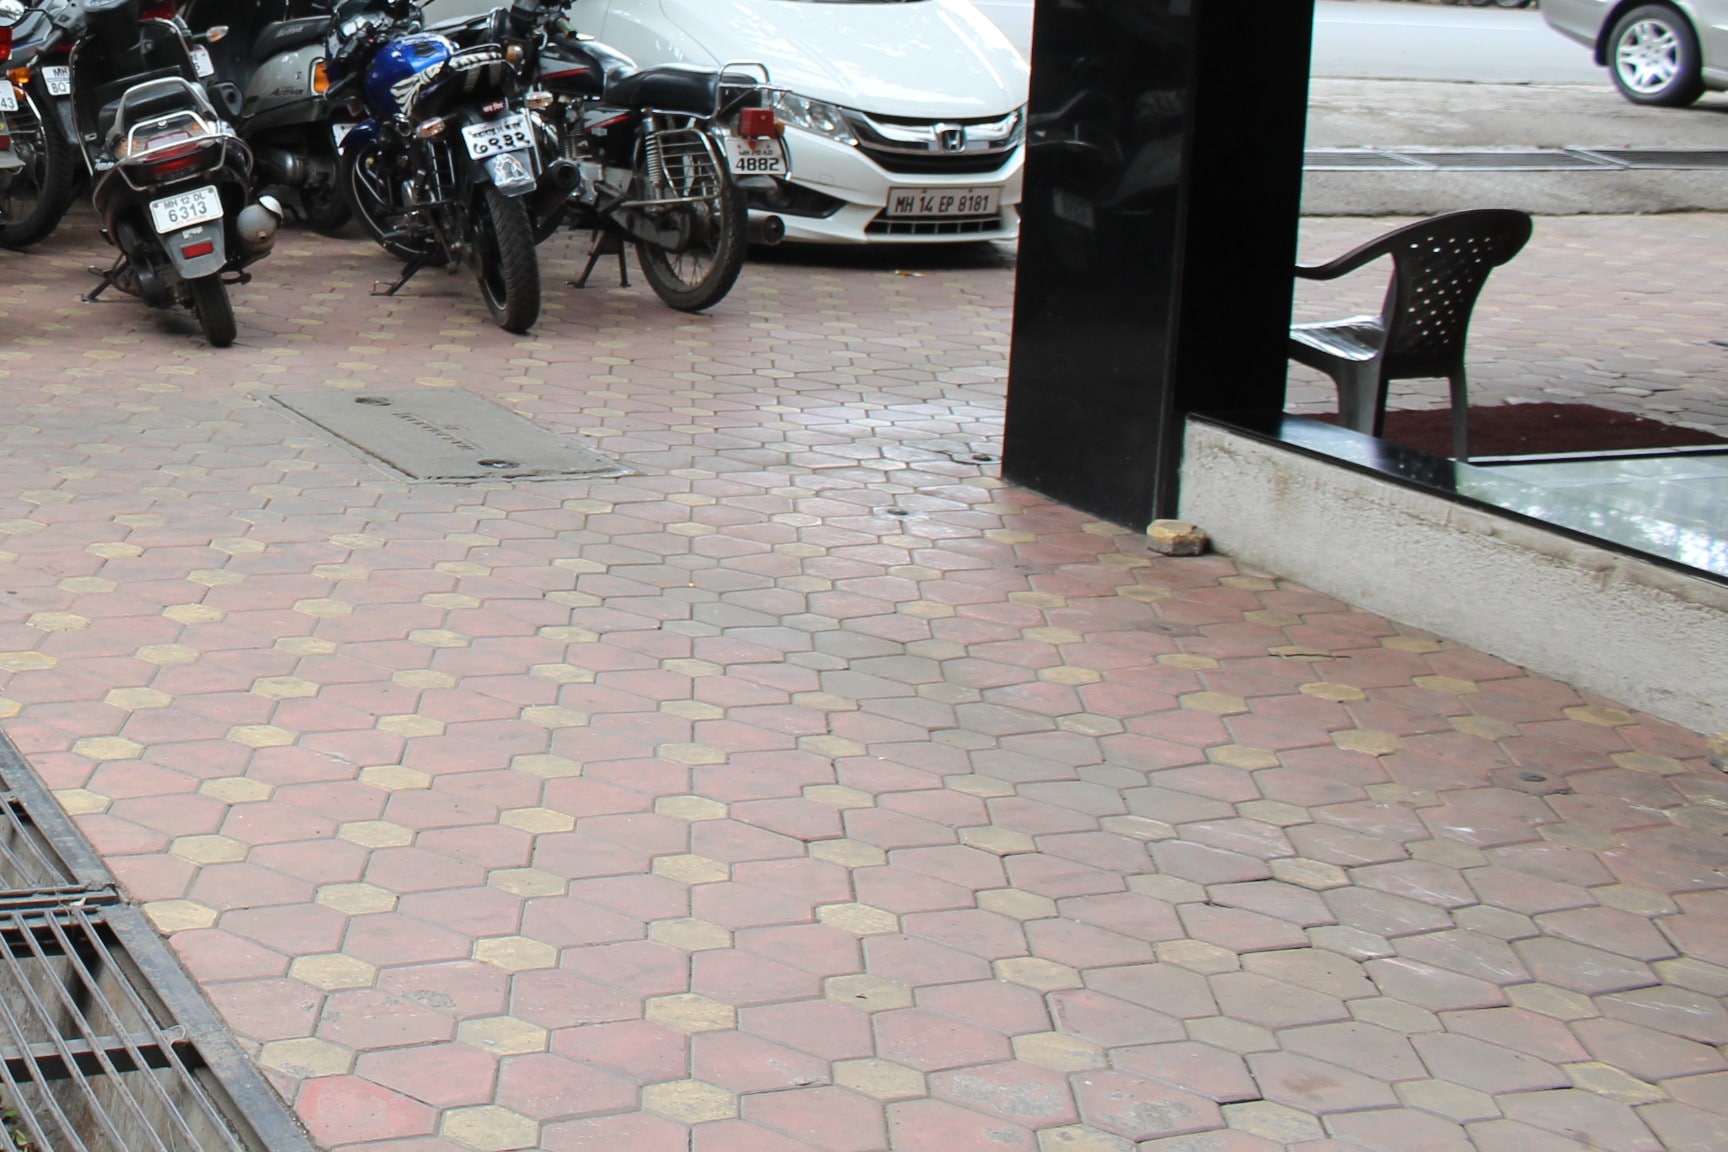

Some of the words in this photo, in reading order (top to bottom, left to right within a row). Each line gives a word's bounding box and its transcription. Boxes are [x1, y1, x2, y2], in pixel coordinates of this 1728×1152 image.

[735, 157, 780, 171] 4882
[163, 199, 178, 209] MH
[180, 196, 190, 205] 12
[192, 192, 206, 202] DL
[894, 195, 915, 213] MH
[919, 195, 935, 213] 14
[938, 195, 955, 213] EP
[958, 194, 990, 212] 8181
[168, 200, 208, 223] 6313
